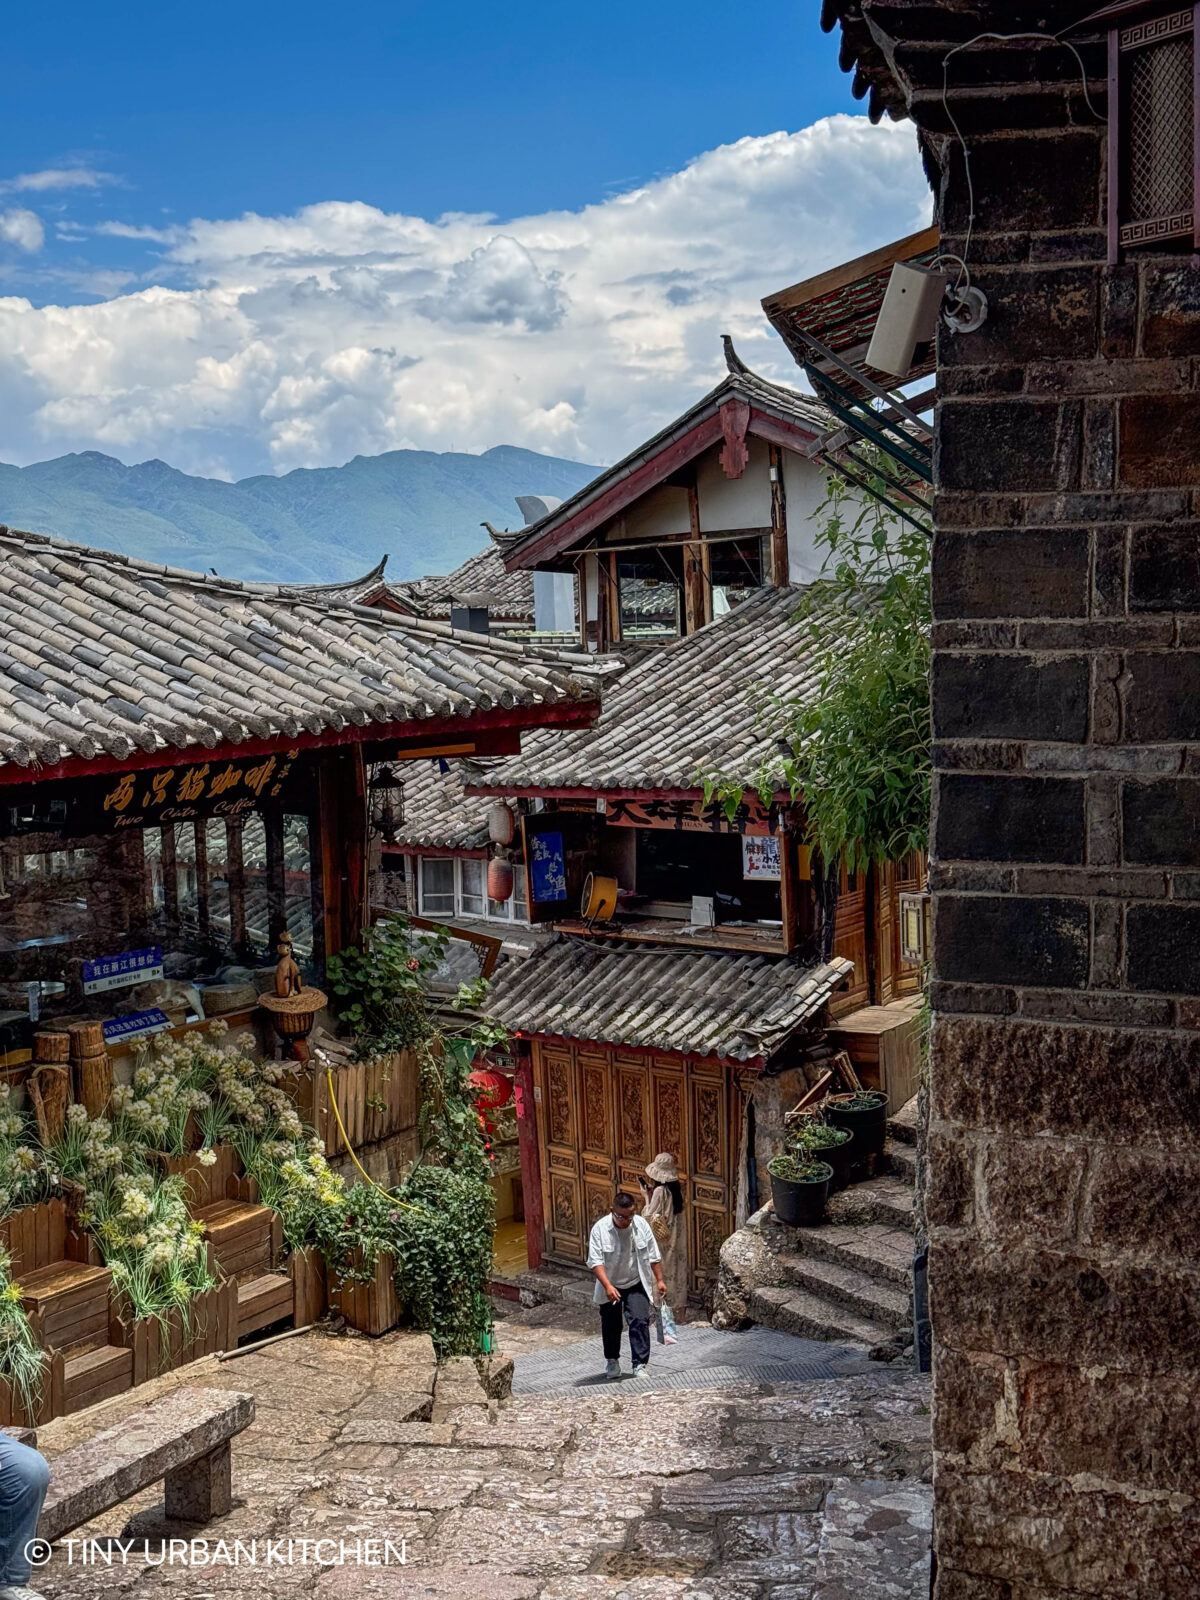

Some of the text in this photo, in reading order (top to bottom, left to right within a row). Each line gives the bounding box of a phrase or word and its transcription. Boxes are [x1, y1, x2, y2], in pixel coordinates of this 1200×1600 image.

[103, 756, 276, 811] 两只猫咖啡
[109, 815, 143, 828] Two
[213, 797, 256, 814] Coffee
[93, 954, 154, 977] 我在丽江很想你
